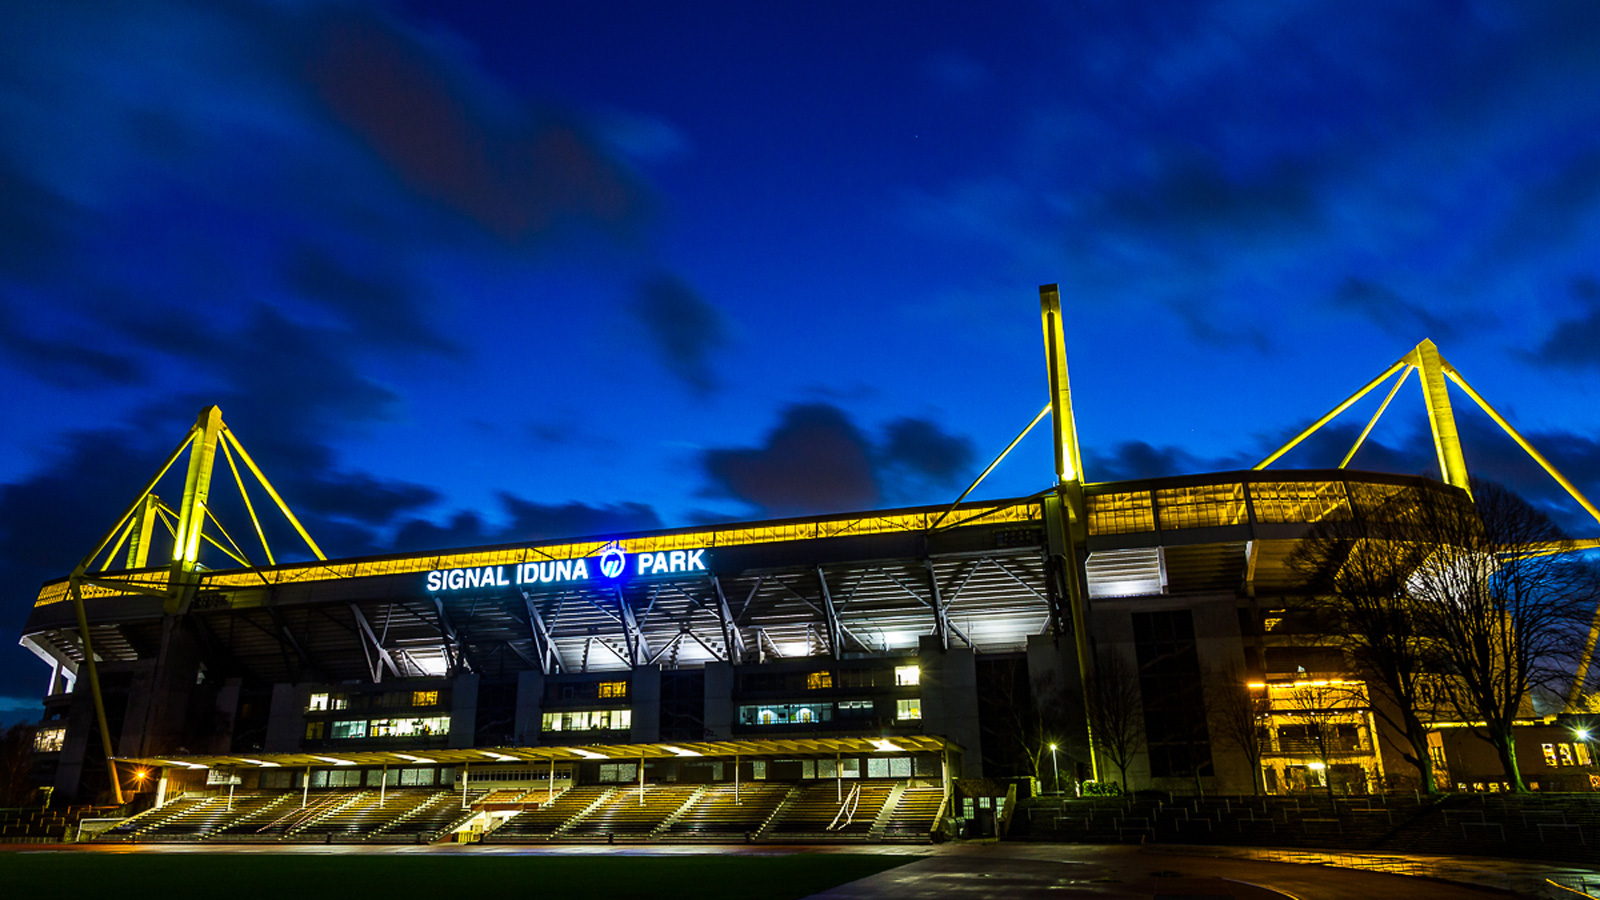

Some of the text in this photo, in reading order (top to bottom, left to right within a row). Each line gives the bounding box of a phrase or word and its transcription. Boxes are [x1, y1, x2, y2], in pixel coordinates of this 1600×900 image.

[426, 549, 706, 592] SIGNAL IDUNA PARK
